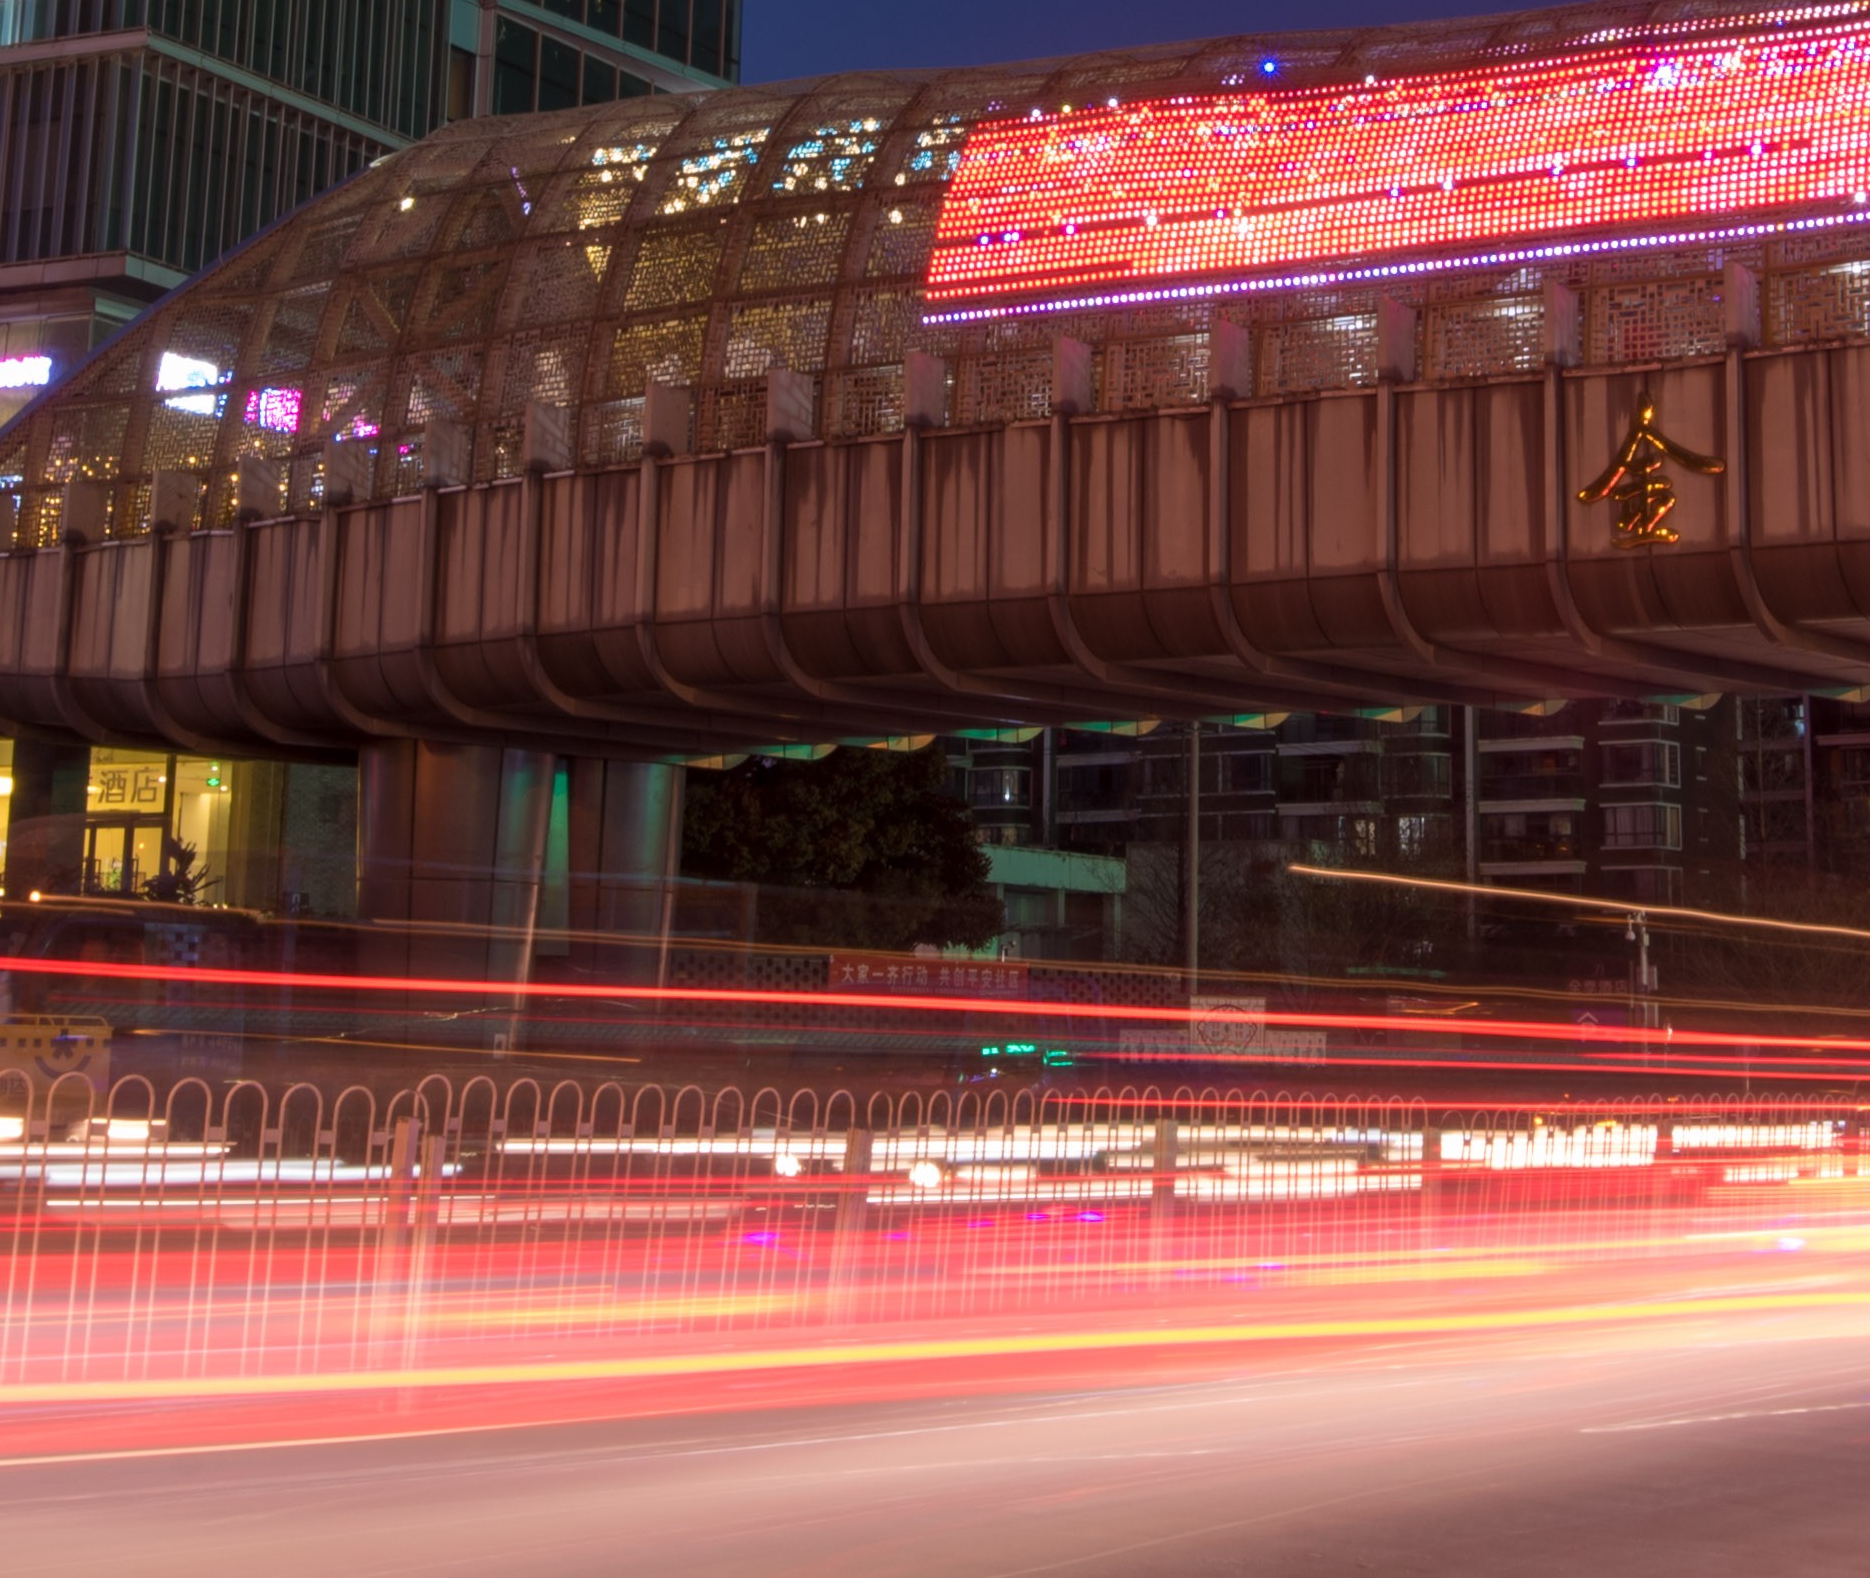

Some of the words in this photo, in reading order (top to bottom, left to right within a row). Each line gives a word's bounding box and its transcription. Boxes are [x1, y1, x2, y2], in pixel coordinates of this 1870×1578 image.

[841, 963, 929, 986] 大家一齐行动
[939, 967, 1020, 988] 共创平安社区
